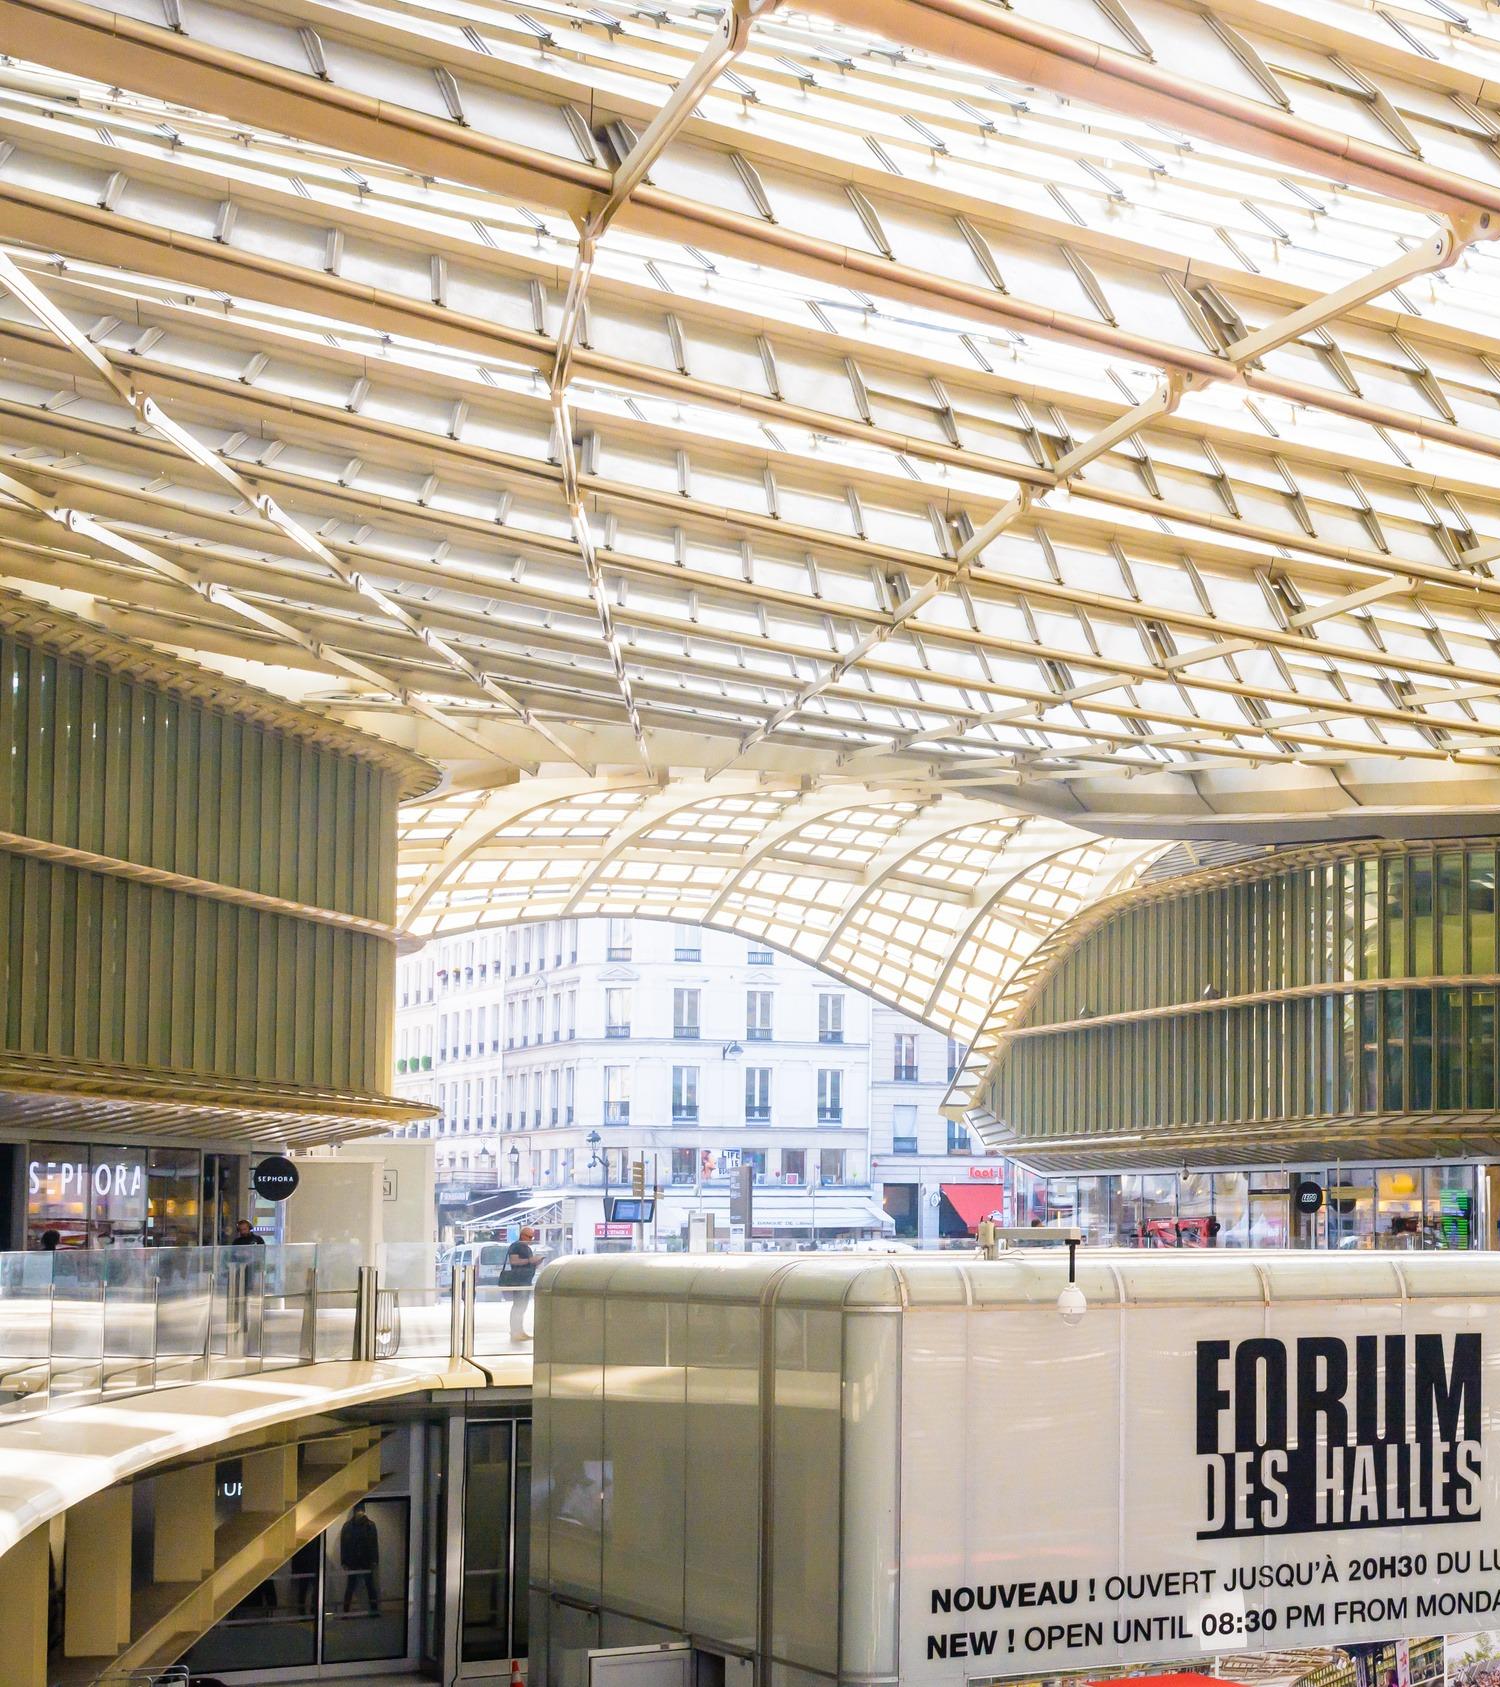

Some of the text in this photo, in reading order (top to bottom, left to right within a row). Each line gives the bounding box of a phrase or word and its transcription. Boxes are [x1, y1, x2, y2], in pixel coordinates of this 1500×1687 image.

[1302, 1193, 1318, 1203] LEGO
[1196, 1332, 1482, 1454] FORUM
[1196, 1437, 1482, 1533] DES HALLES
[931, 1579, 1078, 1614] NOUVEAU
[1088, 1578, 1097, 1604] !
[1104, 1569, 1217, 1601] OUVERT
[1223, 1553, 1339, 1592] JUSQU'À
[1348, 1554, 1427, 1582] 20H30
[1437, 1550, 1471, 1575] DU
[927, 1630, 998, 1660] NEW
[1007, 1628, 1016, 1654] !
[1024, 1621, 1103, 1652] OPEN
[1113, 1615, 1193, 1644] UNTIL
[1201, 1608, 1277, 1636] 08:30
[1286, 1603, 1325, 1629] PM
[1334, 1596, 1408, 1625] FROM
